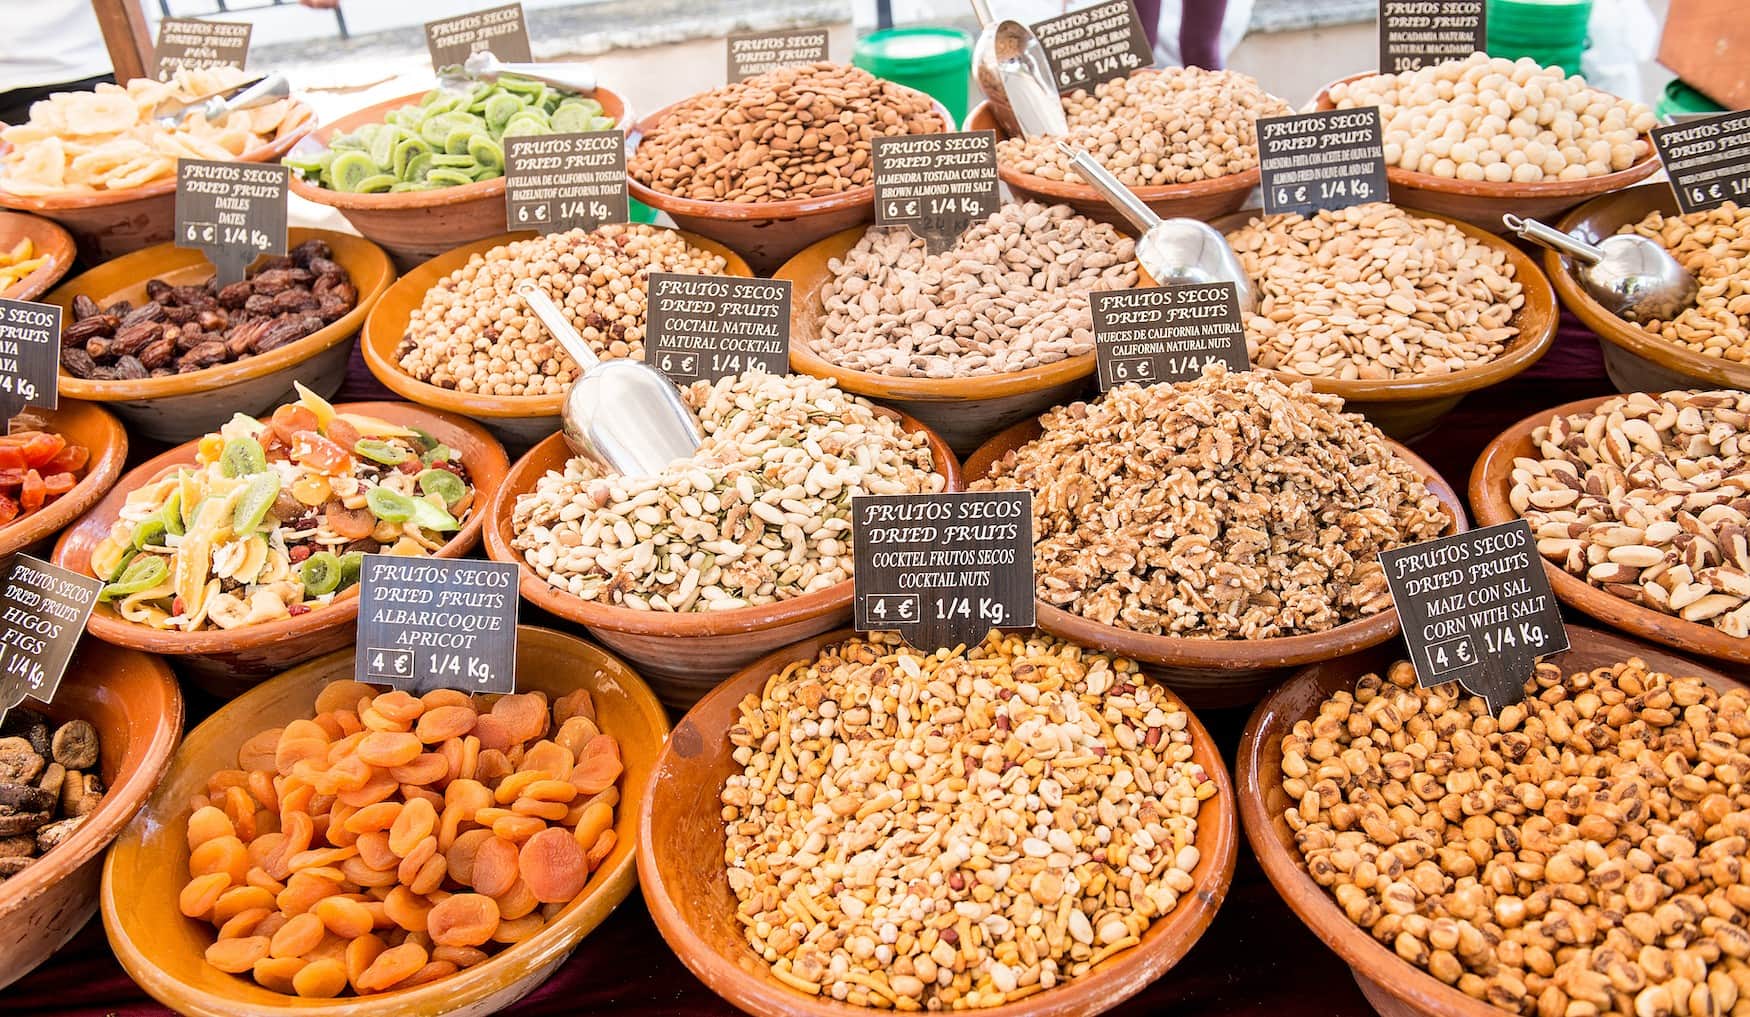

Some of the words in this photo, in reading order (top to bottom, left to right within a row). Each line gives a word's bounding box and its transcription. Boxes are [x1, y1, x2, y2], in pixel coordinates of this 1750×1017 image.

[1384, 2, 1440, 16] FRUTOS
[1442, 2, 1481, 14] SECOS
[163, 22, 213, 35] FRUTOS
[213, 24, 249, 36] SECOS
[431, 16, 481, 38] FRUTOS
[483, 8, 519, 24] SECOS
[1037, 13, 1089, 38] FRUTOS
[1090, 1, 1128, 21] SECOS
[1388, 16, 1430, 27] DRIED
[1431, 16, 1479, 29] FRUITS
[165, 34, 202, 45] DRIED
[201, 36, 243, 47] FRUITS
[435, 31, 475, 48] DRIED
[476, 21, 519, 40] FRUITS
[1043, 28, 1084, 48] DRIED
[1085, 13, 1130, 36] FRUITS
[1440, 32, 1475, 40] NATURAL
[732, 38, 784, 53] FRUTOS
[787, 35, 824, 47] SECOS
[735, 51, 775, 63] DRIED
[776, 48, 822, 61] FRUITS
[1060, 72, 1070, 84] 6
[1074, 67, 1085, 80] €
[1095, 56, 1118, 74] 1/4
[1120, 53, 1141, 68] Kg.
[1263, 118, 1326, 140] FRUTOS
[1329, 112, 1374, 129] SECOS
[1661, 124, 1720, 148] FRUTOS
[510, 139, 571, 157] FRUTOS
[575, 137, 619, 151] SECOS
[879, 140, 941, 157] FRUTOS
[945, 137, 989, 151] SECOS
[1269, 137, 1317, 152] DRIED
[1320, 130, 1372, 148] FRUITS
[1669, 141, 1716, 158] DRIED
[515, 157, 561, 170] DRIED
[564, 153, 616, 169] FRUITS
[884, 156, 931, 169] DRIED
[934, 152, 987, 167] FRUITS
[183, 165, 240, 180] FRUTOS
[242, 169, 284, 184] SECOS
[508, 176, 541, 187] AVELLANA
[542, 175, 552, 185] DE
[554, 173, 594, 184] CALIFORNIA
[595, 171, 626, 181] TOSTADA
[876, 173, 922, 185] ALMENDRA
[923, 171, 960, 182] TOSTADA
[961, 169, 980, 179] CON
[981, 167, 996, 178] SAL
[186, 181, 229, 194] DRIED
[231, 184, 280, 198] FRUITS
[558, 186, 599, 198] CALIFORNIA
[600, 184, 622, 194] TOAST
[882, 186, 912, 198] BROWN
[913, 184, 949, 196] ALMOND
[950, 183, 971, 193] WITH
[973, 181, 993, 192] SALT
[1320, 181, 1346, 198] 1/4
[1351, 179, 1373, 198] Kg.
[215, 197, 250, 211] DATILES
[519, 206, 528, 221] 6
[535, 205, 546, 220] €
[561, 202, 585, 218] 1/4
[590, 201, 612, 220] Kg.
[888, 202, 898, 216] 6
[905, 201, 916, 215] €
[931, 198, 956, 214] 1/4
[961, 198, 984, 216] Kg.
[218, 212, 246, 225] DATES
[187, 225, 196, 240] 6
[203, 227, 213, 241] €
[224, 227, 247, 243] 1/4
[251, 229, 272, 249] Kg.
[656, 281, 729, 296] FRUTOS
[733, 285, 784, 300] SECOS
[1099, 292, 1172, 312] FRUTOS
[1177, 288, 1229, 304] SECOS
[8, 309, 54, 327] SECOS
[660, 299, 715, 314] DRIED
[718, 302, 779, 317] FRUITS
[1106, 310, 1161, 325] DRIED
[1166, 304, 1228, 322] FRUITS
[665, 318, 719, 333] COCTAIL
[722, 321, 779, 336] NATURAL
[1098, 332, 1133, 343] NUECES
[1134, 330, 1146, 340] DE
[1148, 325, 1200, 339] CALIFORNIA
[1202, 323, 1242, 335] NATURAL
[659, 335, 717, 349] NATURAL
[720, 338, 783, 353] COCKTAIL
[1113, 341, 1164, 356] CALIFORNIA
[1166, 340, 1207, 352] NATURAL
[1208, 338, 1231, 349] NUTS
[662, 354, 672, 371] 6
[681, 357, 694, 372] €
[712, 354, 740, 372] 1/4
[1117, 362, 1128, 378] 6
[1137, 362, 1149, 376] €
[1170, 356, 1199, 374] 1/4
[17, 378, 39, 400] Kg.
[863, 501, 952, 525] FRUTOS
[958, 500, 1022, 519] SECOS
[869, 527, 937, 544] DRIED
[942, 523, 1018, 544] FRUITS
[873, 552, 927, 568] COCKTEL
[930, 551, 975, 566] FRUTOS
[977, 549, 1015, 565] SECOS
[1395, 543, 1470, 579] FRUTOS
[1474, 530, 1526, 556] SECOS
[369, 565, 448, 584] FRUTOS
[453, 569, 510, 587] SECOS
[899, 573, 958, 588] COCKTAIL
[960, 571, 990, 586] NUTS
[1406, 569, 1464, 596] DRIED
[1468, 552, 1529, 585] FRUITS
[9, 565, 58, 592] FRUTOS
[56, 580, 93, 604] SECOS
[5, 585, 41, 607] DRIED
[37, 598, 80, 623] FRUITS
[374, 587, 433, 604] DRIED
[436, 591, 504, 609] FRUITS
[1427, 595, 1466, 617] MAIZ
[1468, 585, 1500, 606] CON
[1503, 578, 1531, 598] SAL
[373, 609, 502, 632] ALBARICOQUE
[873, 598, 887, 619] 4
[898, 599, 913, 618] €
[936, 598, 971, 619] 1/4
[980, 597, 1010, 624] Kg.
[1424, 617, 1466, 641] CORN
[1468, 605, 1509, 629] WITH
[1512, 596, 1546, 618] SALT
[2, 607, 63, 639] HIGOS
[1, 628, 46, 655] FIGS
[396, 631, 476, 649] APRICOT
[1436, 647, 1449, 667] 4
[1456, 641, 1471, 662] €
[1484, 626, 1516, 653] 1/4
[1519, 623, 1549, 648] Kg.
[7, 654, 31, 678] 1/4
[28, 662, 44, 689] Kg.
[373, 653, 384, 671] 4
[395, 654, 408, 674] €
[430, 654, 460, 675] 1/4
[468, 657, 495, 683] Kg.
